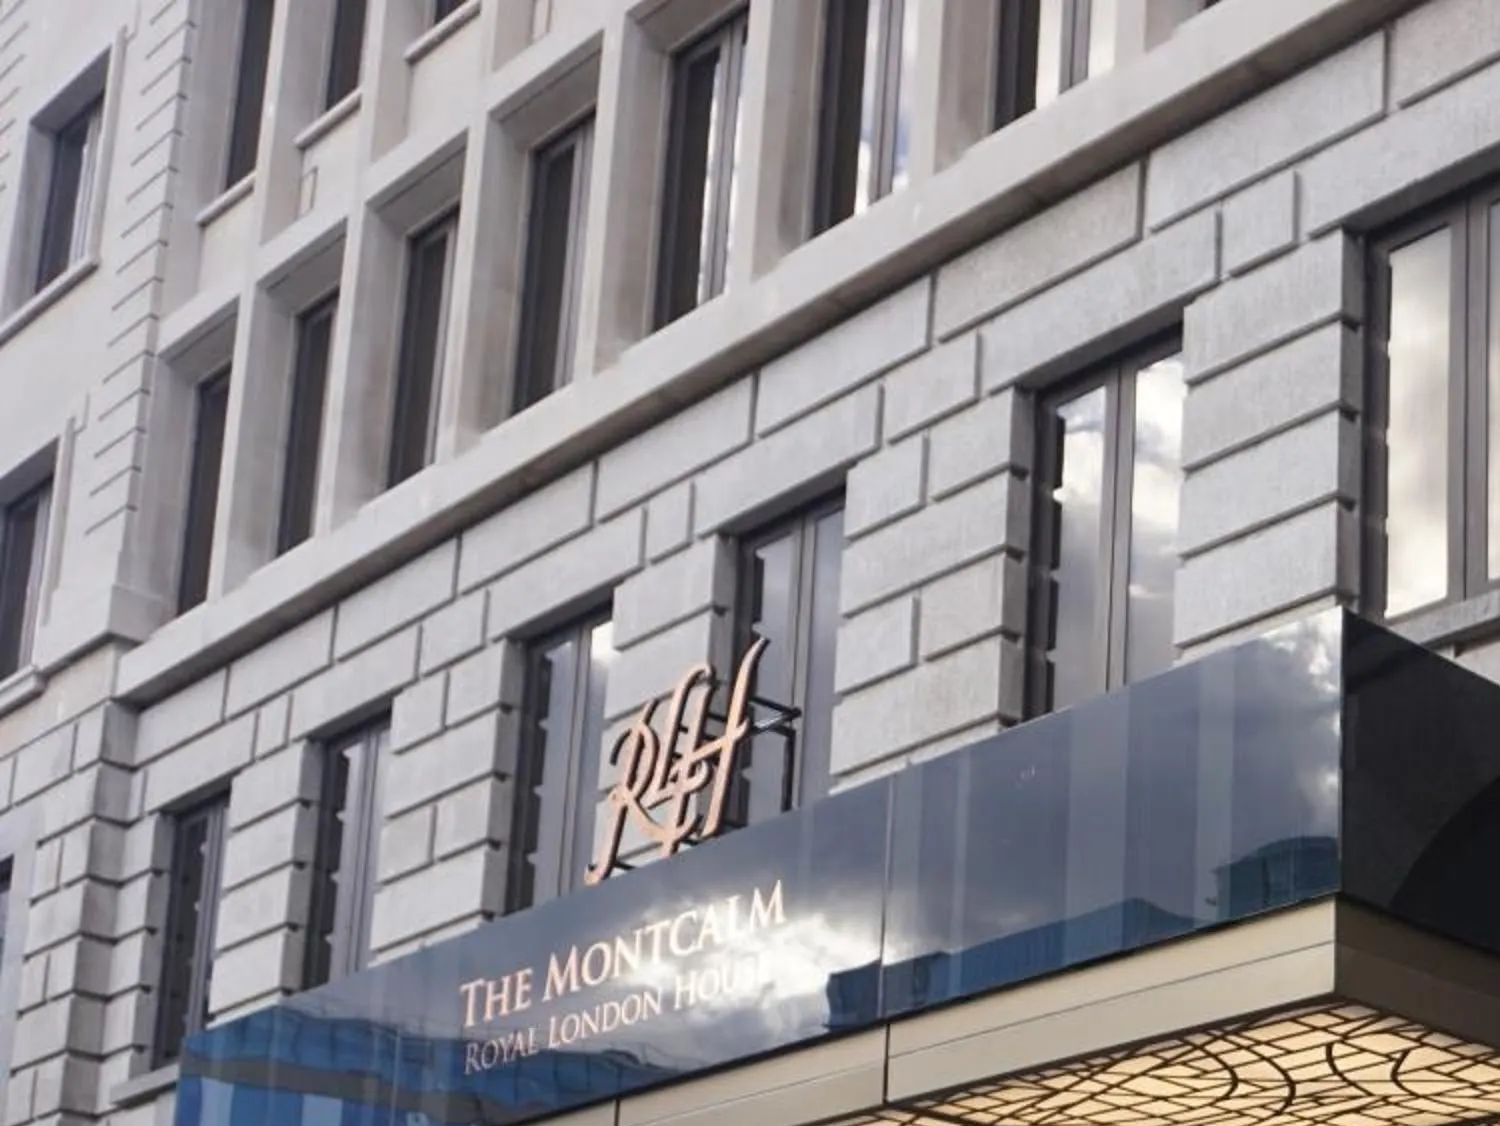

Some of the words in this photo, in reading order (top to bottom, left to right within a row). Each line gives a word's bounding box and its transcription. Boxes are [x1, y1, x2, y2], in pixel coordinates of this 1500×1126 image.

[460, 967, 535, 1028] THE
[542, 879, 787, 1003] MONTCALM
[463, 1027, 540, 1076] ROYAL
[547, 988, 663, 1050] LONDON
[673, 946, 772, 1010] HOU
